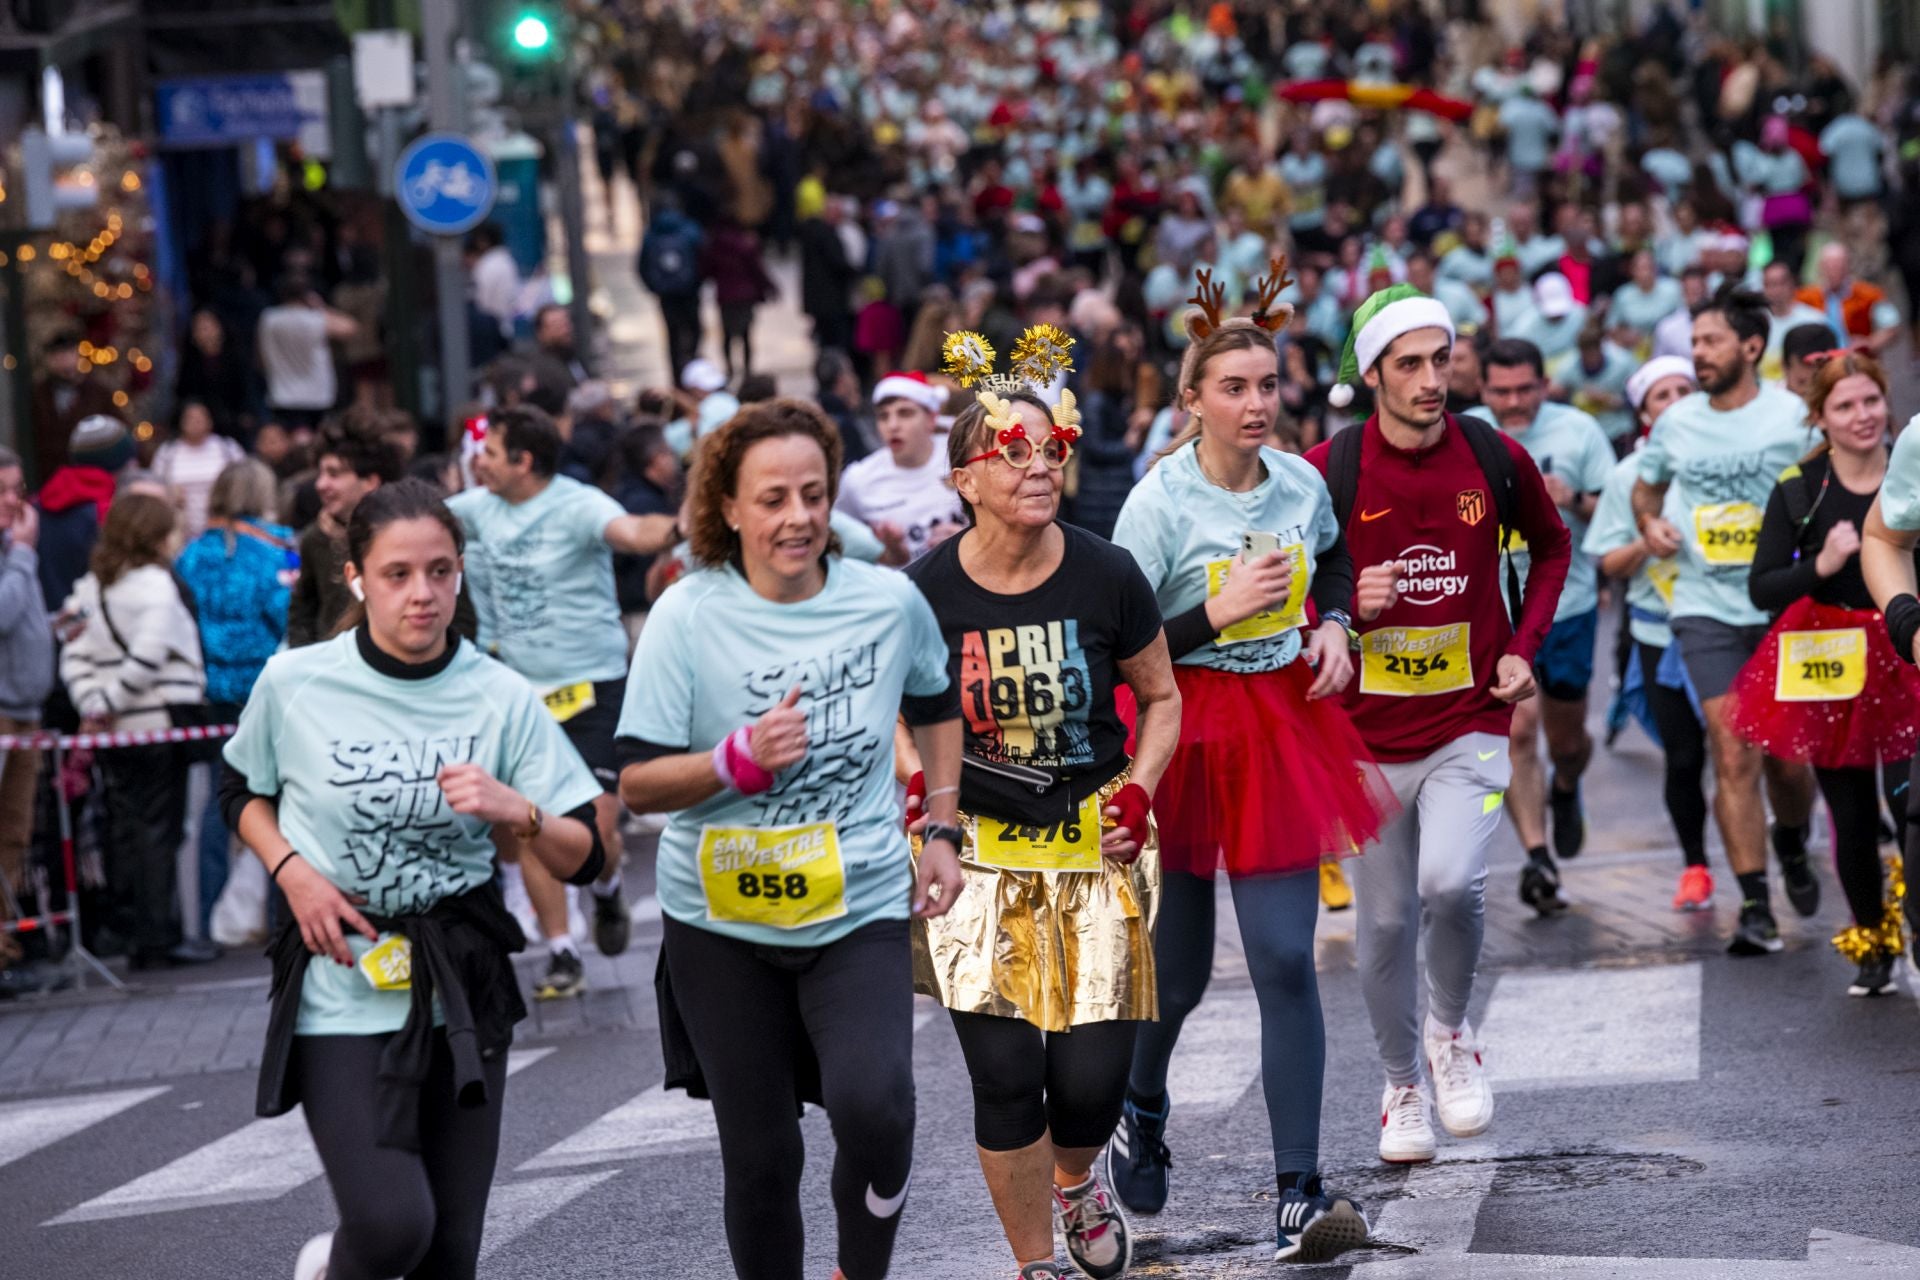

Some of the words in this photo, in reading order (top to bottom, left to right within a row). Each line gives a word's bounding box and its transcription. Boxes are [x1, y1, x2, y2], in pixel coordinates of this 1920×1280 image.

[1706, 530, 1758, 546] 2902
[1396, 575, 1468, 596] energy
[961, 619, 1085, 675] APRIL
[1372, 630, 1407, 645] SAN
[1372, 626, 1460, 654] SILVESTRE
[1384, 653, 1449, 676] 2134
[1802, 661, 1844, 679] 2119
[967, 666, 1088, 721] 1963
[328, 735, 477, 787] SAN
[998, 819, 1081, 843] 2476
[713, 836, 757, 854] SAN
[713, 828, 825, 874] SILVESTRE
[738, 873, 809, 899] 858
